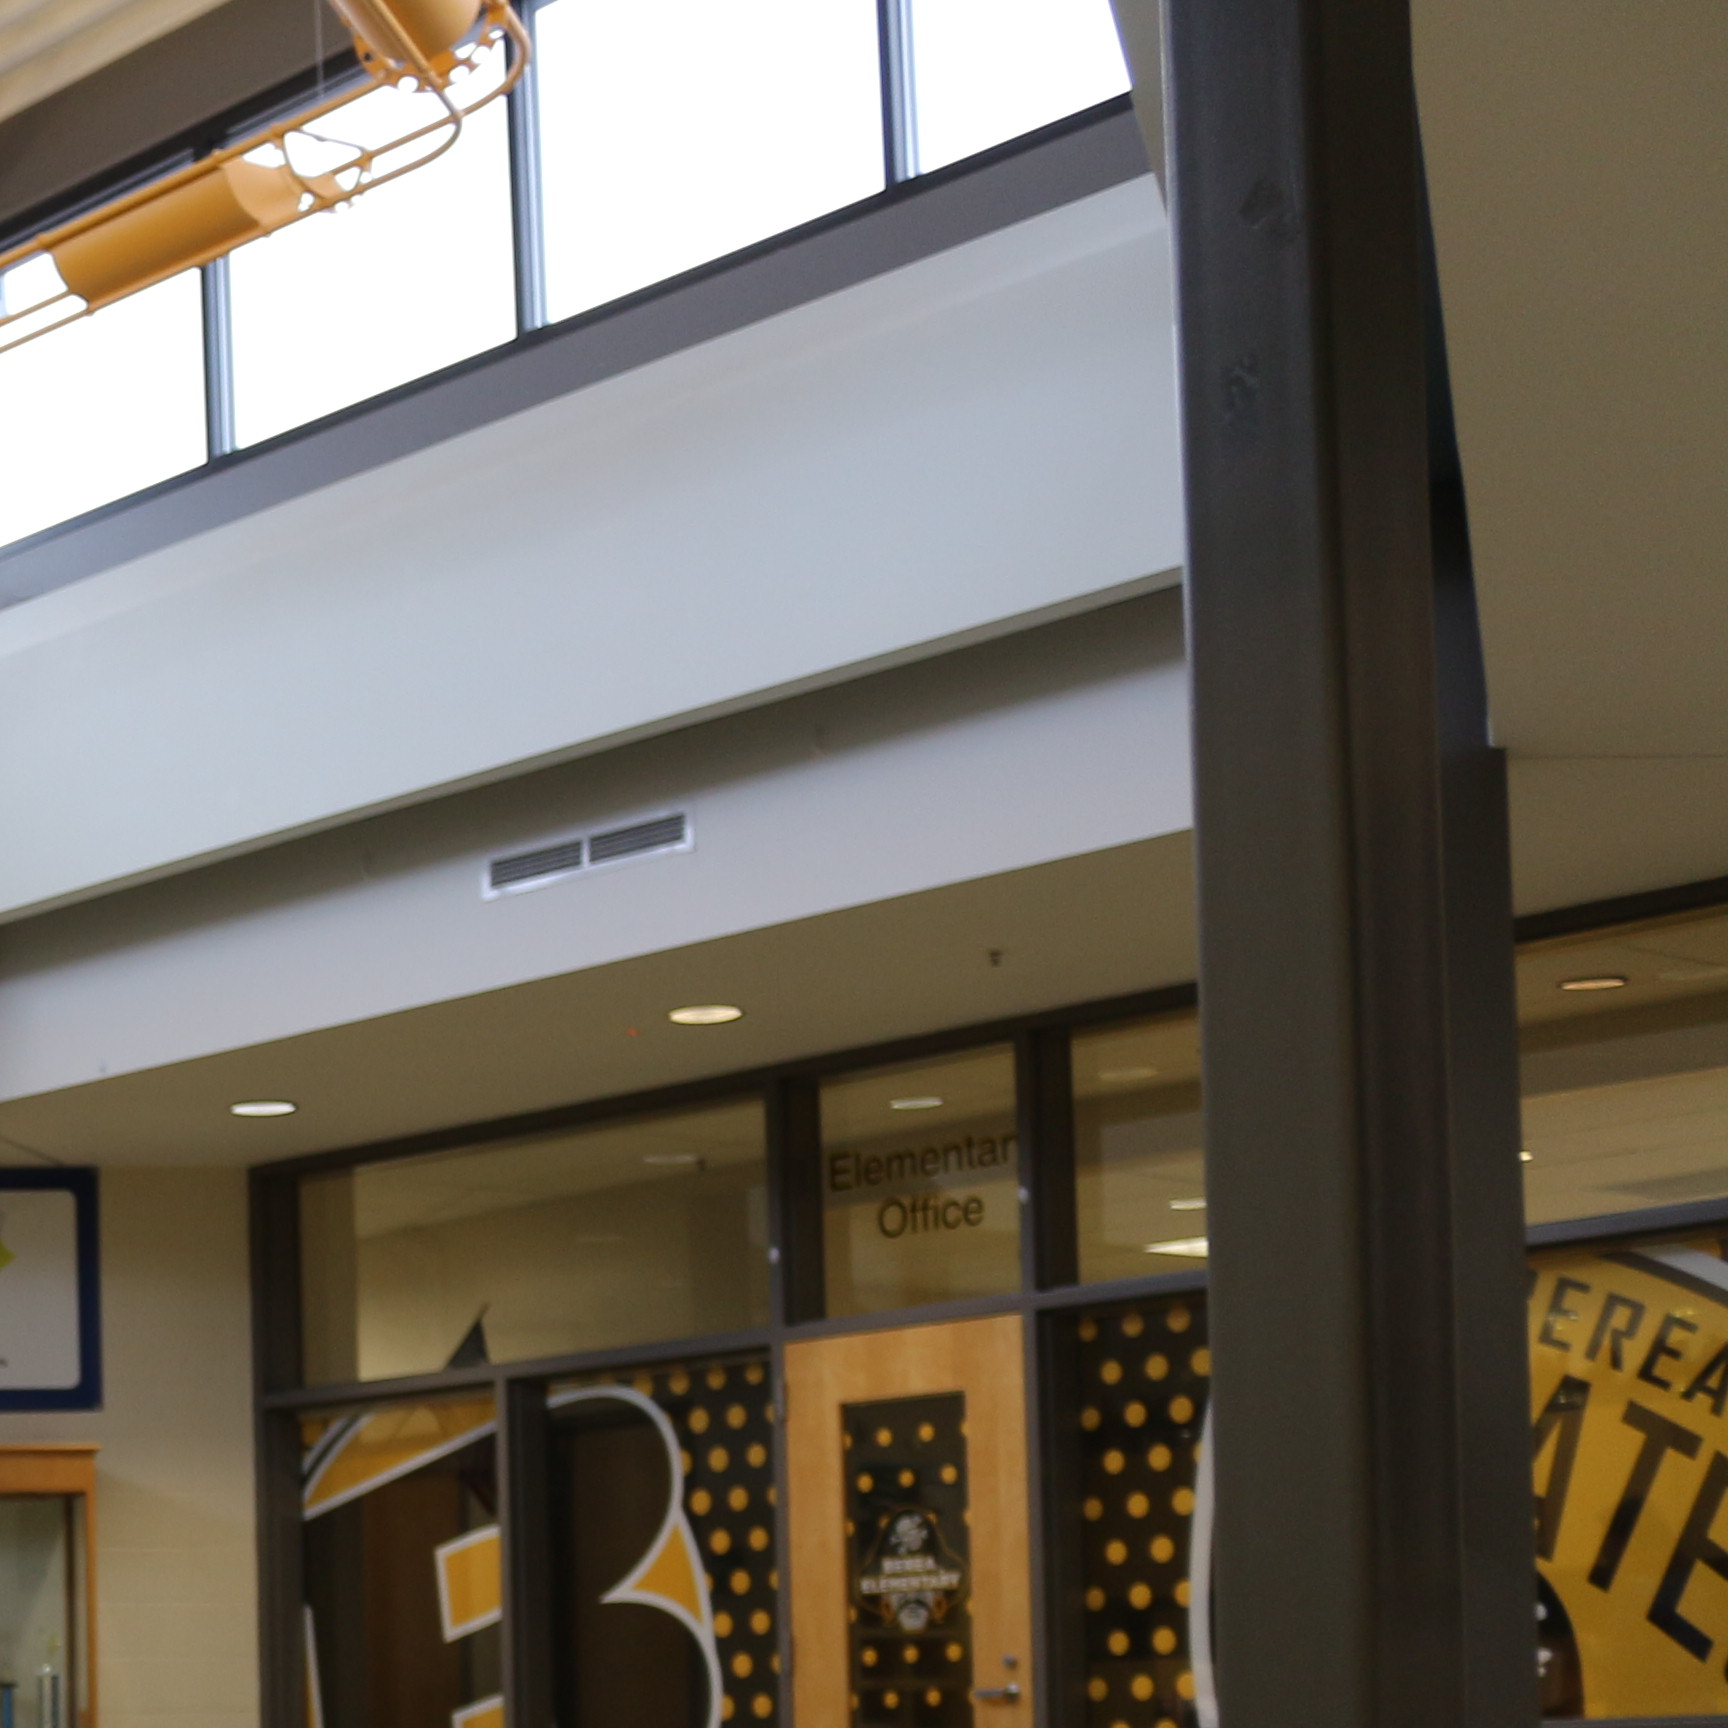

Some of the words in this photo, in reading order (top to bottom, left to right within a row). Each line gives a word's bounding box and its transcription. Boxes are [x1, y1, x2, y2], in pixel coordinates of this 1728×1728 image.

[829, 1132, 1018, 1192] Elementar
[877, 1197, 985, 1239] Office
[1526, 1267, 1728, 1417] EREA
